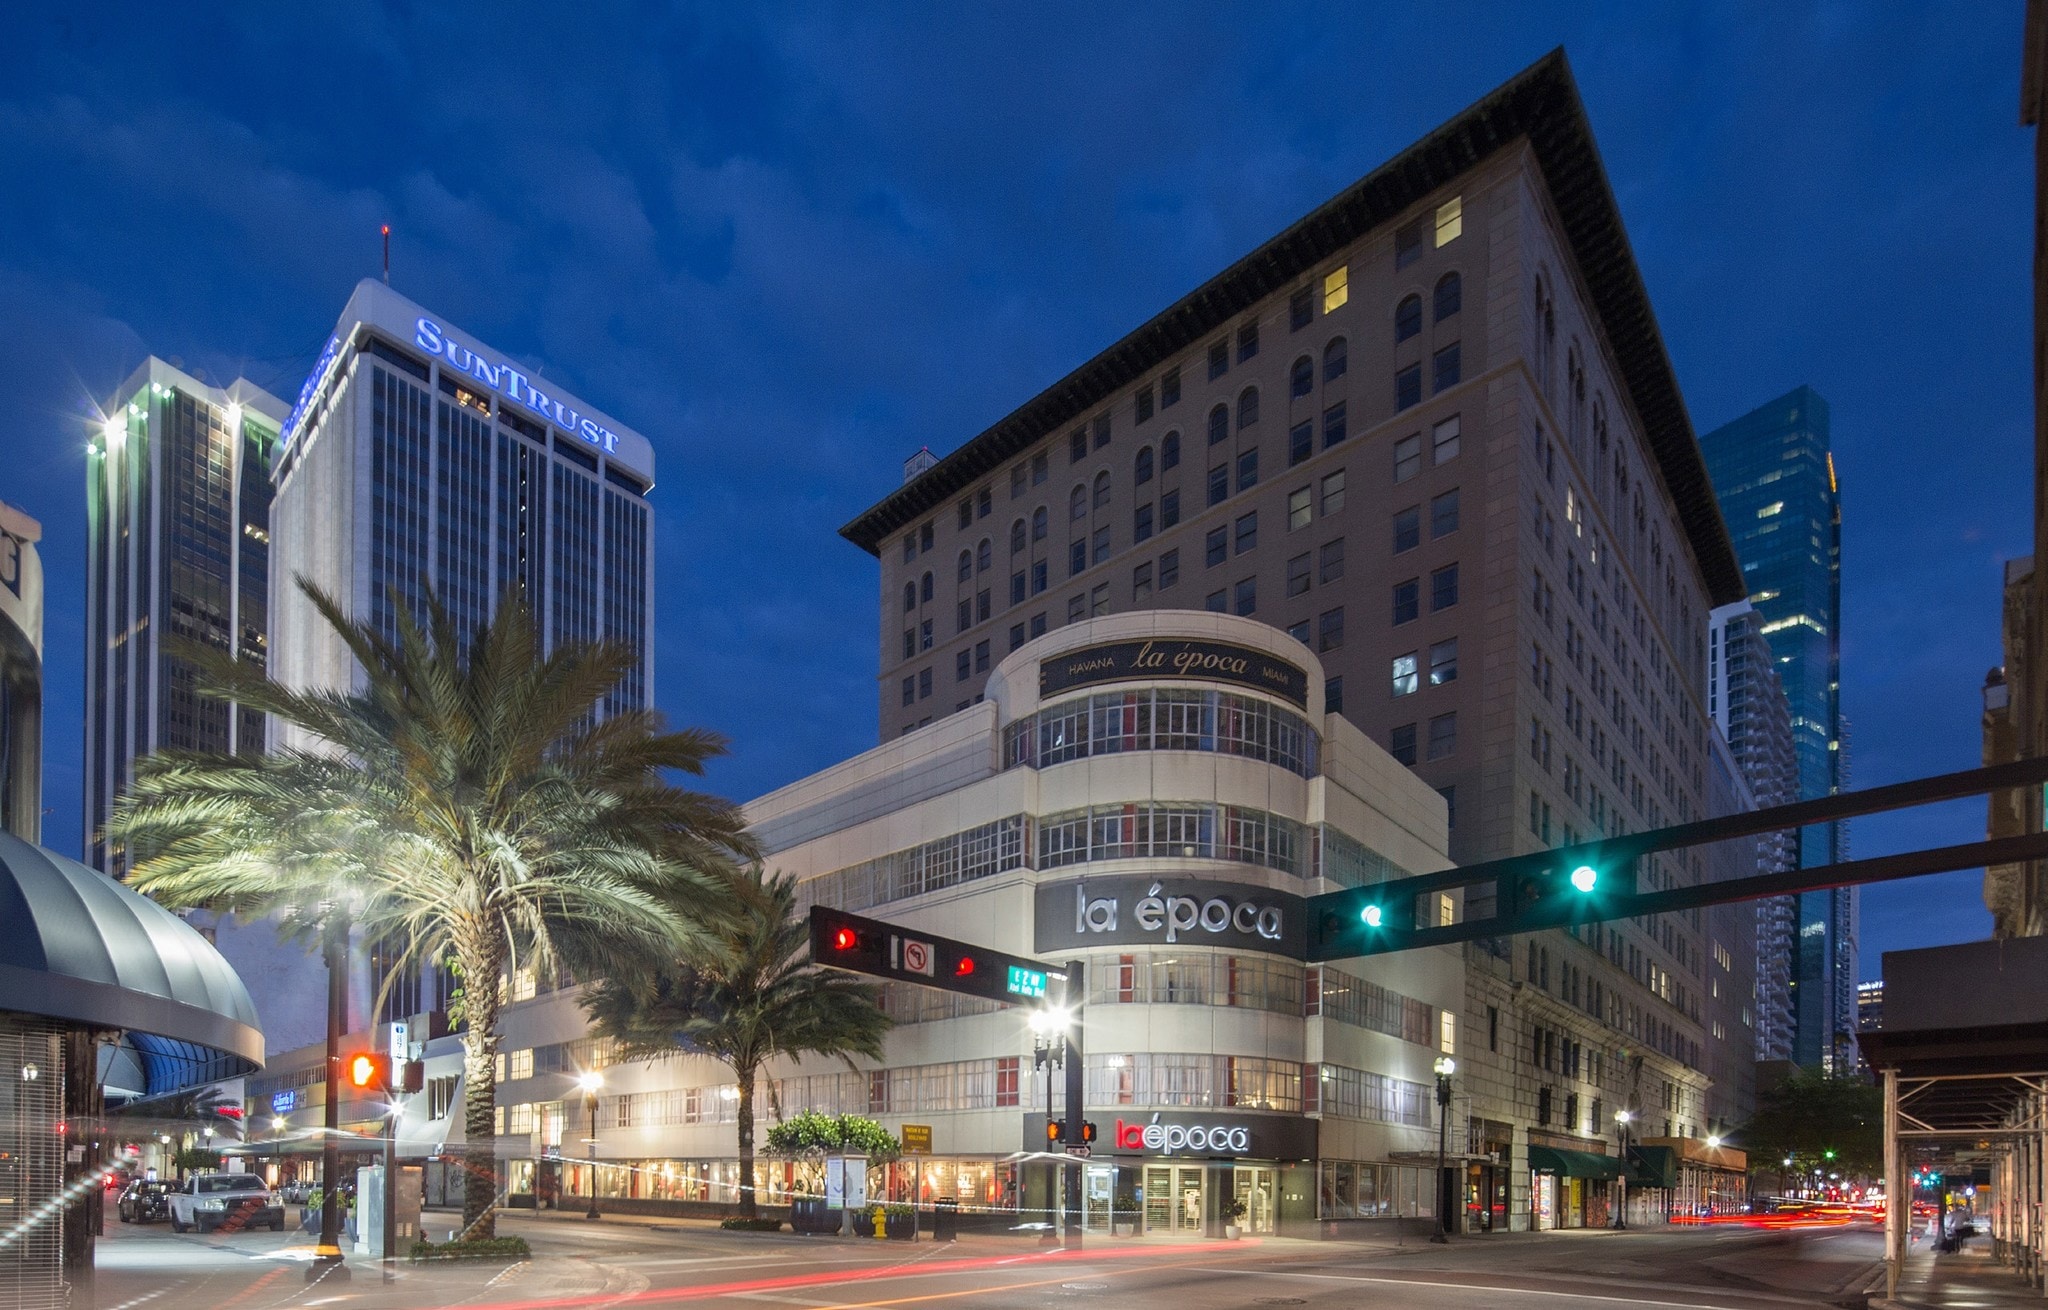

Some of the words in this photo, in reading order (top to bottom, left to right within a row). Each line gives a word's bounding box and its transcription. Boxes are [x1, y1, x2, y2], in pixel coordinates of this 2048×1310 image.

[1069, 656, 1115, 676] HAVANA
[1130, 640, 1167, 668] la
[1173, 643, 1250, 675] época
[1262, 666, 1290, 684] MIAMI
[1076, 883, 1117, 933] la
[1135, 879, 1283, 943] época
[1022, 970, 1029, 986] 2
